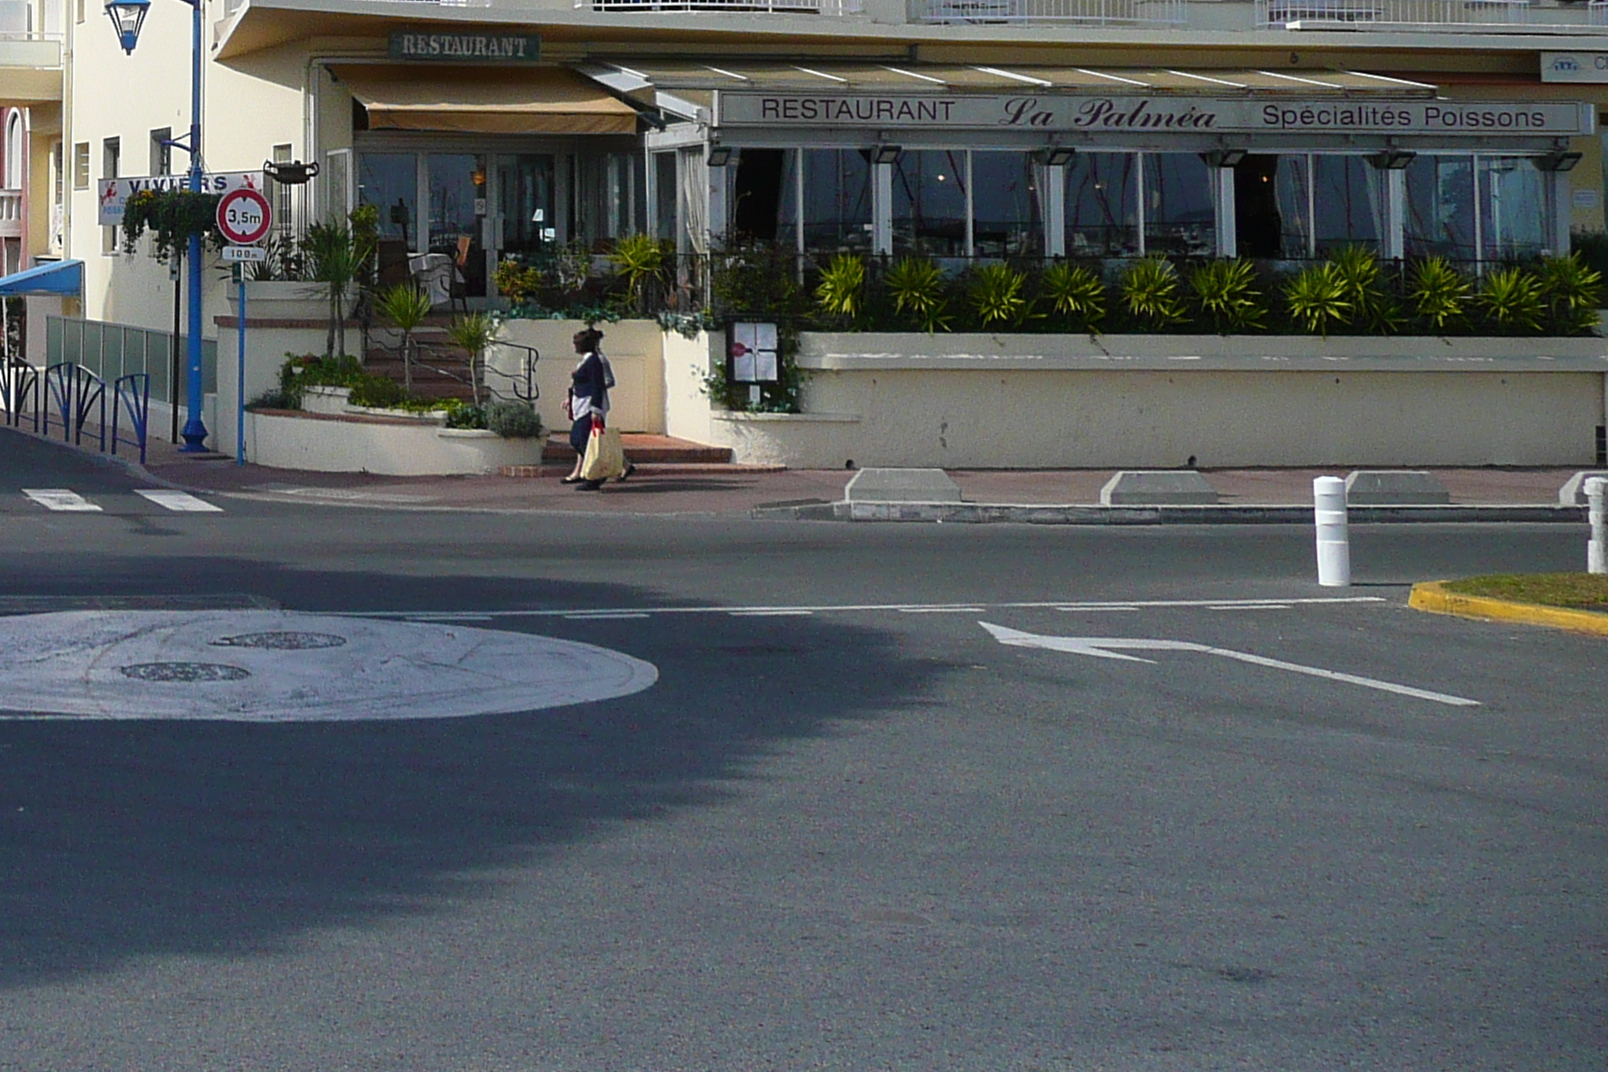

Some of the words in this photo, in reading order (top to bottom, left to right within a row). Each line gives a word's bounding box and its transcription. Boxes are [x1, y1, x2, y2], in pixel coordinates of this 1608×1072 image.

[402, 34, 527, 57] RESTAURANT
[762, 98, 955, 120] RESTAURANT
[998, 97, 1053, 127] La
[1074, 98, 1217, 128] Palméa
[1262, 104, 1412, 129] Spécialités
[1424, 106, 1545, 128] Poissons
[228, 209, 261, 225] 3,5m
